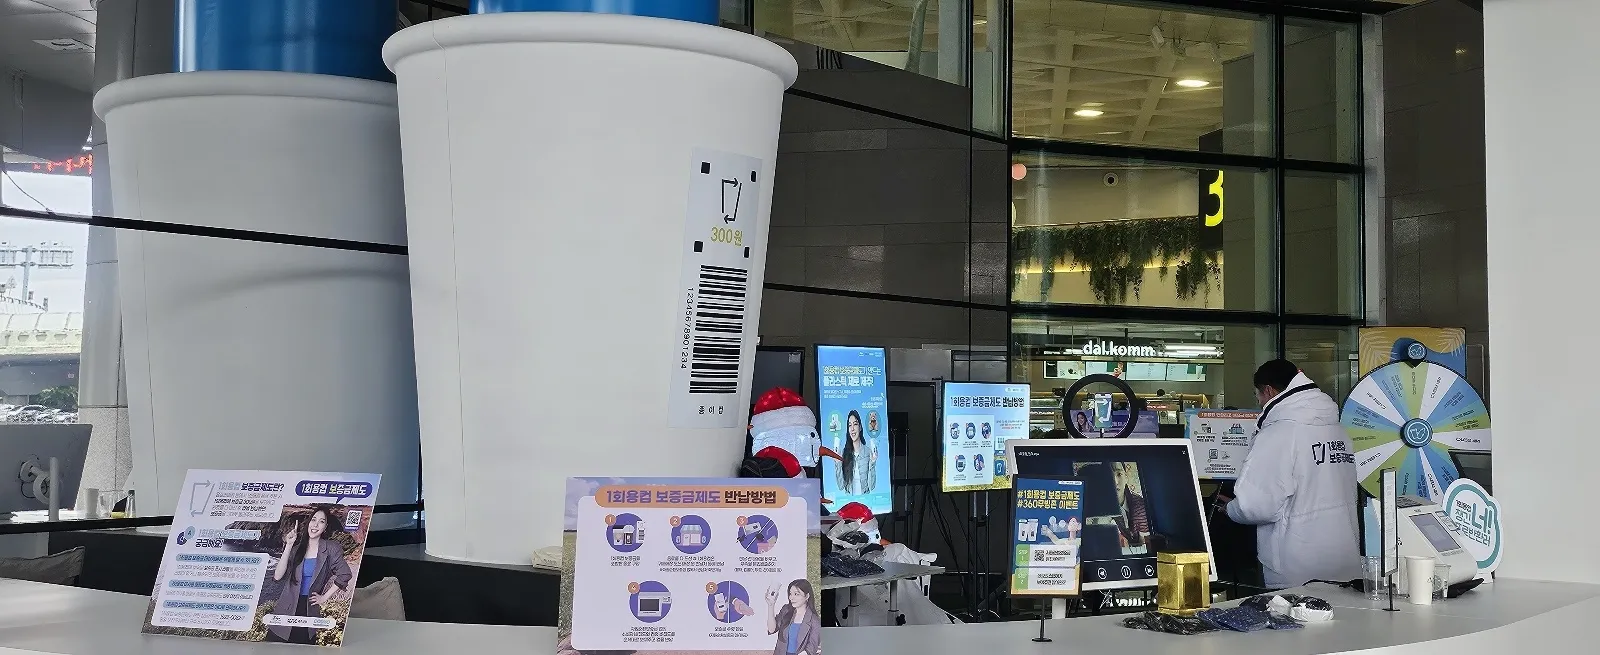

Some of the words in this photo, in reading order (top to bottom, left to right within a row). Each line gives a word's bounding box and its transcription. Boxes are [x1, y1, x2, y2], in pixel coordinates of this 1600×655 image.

[711, 226, 743, 246] 300원
[681, 288, 694, 369] 12345678901234
[302, 484, 327, 494] 1회용컵
[329, 484, 367, 495] 보증금제도
[1017, 490, 1046, 499] #1회용컵
[1048, 490, 1080, 500] 보증금제도
[607, 490, 651, 503] 1회용컵
[656, 491, 720, 504] 보증금제도
[724, 490, 777, 504] 반납방법
[1017, 499, 1057, 509] #360무빙존
[1059, 500, 1079, 510] 이벤트
